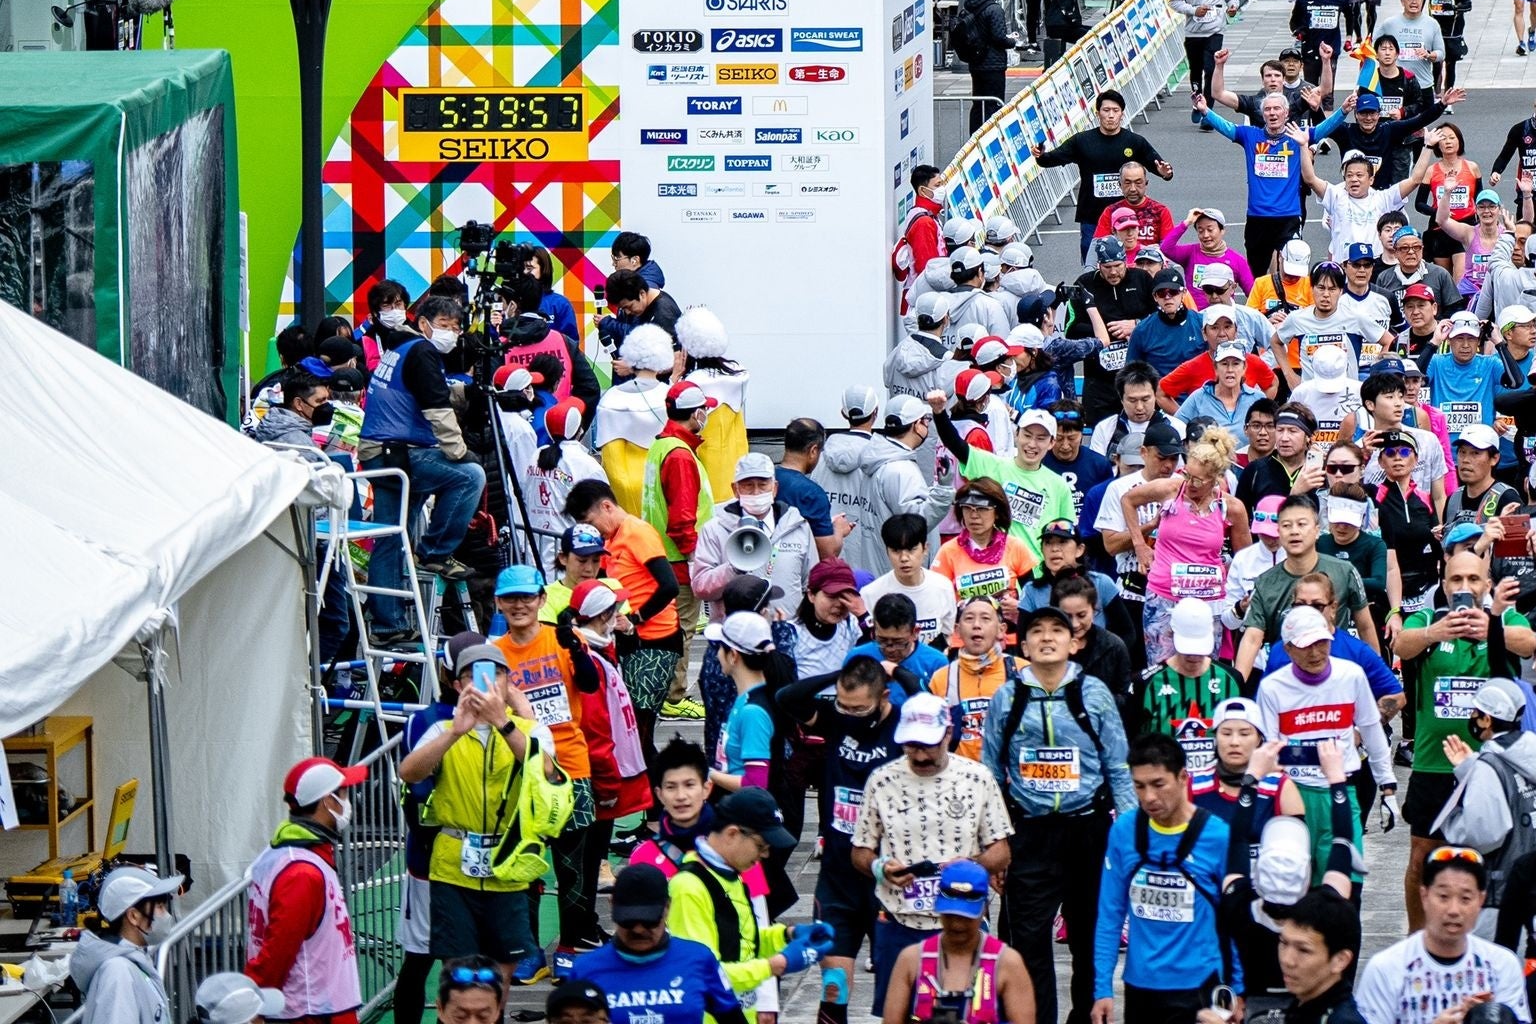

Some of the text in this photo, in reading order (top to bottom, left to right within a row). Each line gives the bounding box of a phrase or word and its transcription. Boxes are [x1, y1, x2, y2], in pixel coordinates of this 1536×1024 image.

[640, 31, 696, 43] TOKIO
[735, 32, 775, 48] asics
[645, 43, 691, 52] インカラミ
[719, 68, 776, 79] SEIKO
[794, 69, 839, 79] 第一生命
[700, 130, 742, 139] こくみん共済
[757, 132, 798, 142] Salonpas
[439, 138, 549, 160] SEIKO
[669, 158, 714, 169] バスクリン
[727, 159, 769, 167] TOPPAN
[659, 185, 697, 196] 日本光電
[1448, 414, 1473, 424] 28290
[1018, 488, 1043, 503] 東京メトロ
[972, 569, 1003, 582] 東京メトロ
[1188, 566, 1216, 574] 東京メトロ
[1038, 751, 1072, 760] 東京メトロ
[1032, 764, 1067, 778] 29685
[1148, 876, 1186, 887] 東京メトロ
[1141, 889, 1178, 908] 82693
[606, 989, 685, 1008] SANJAY
